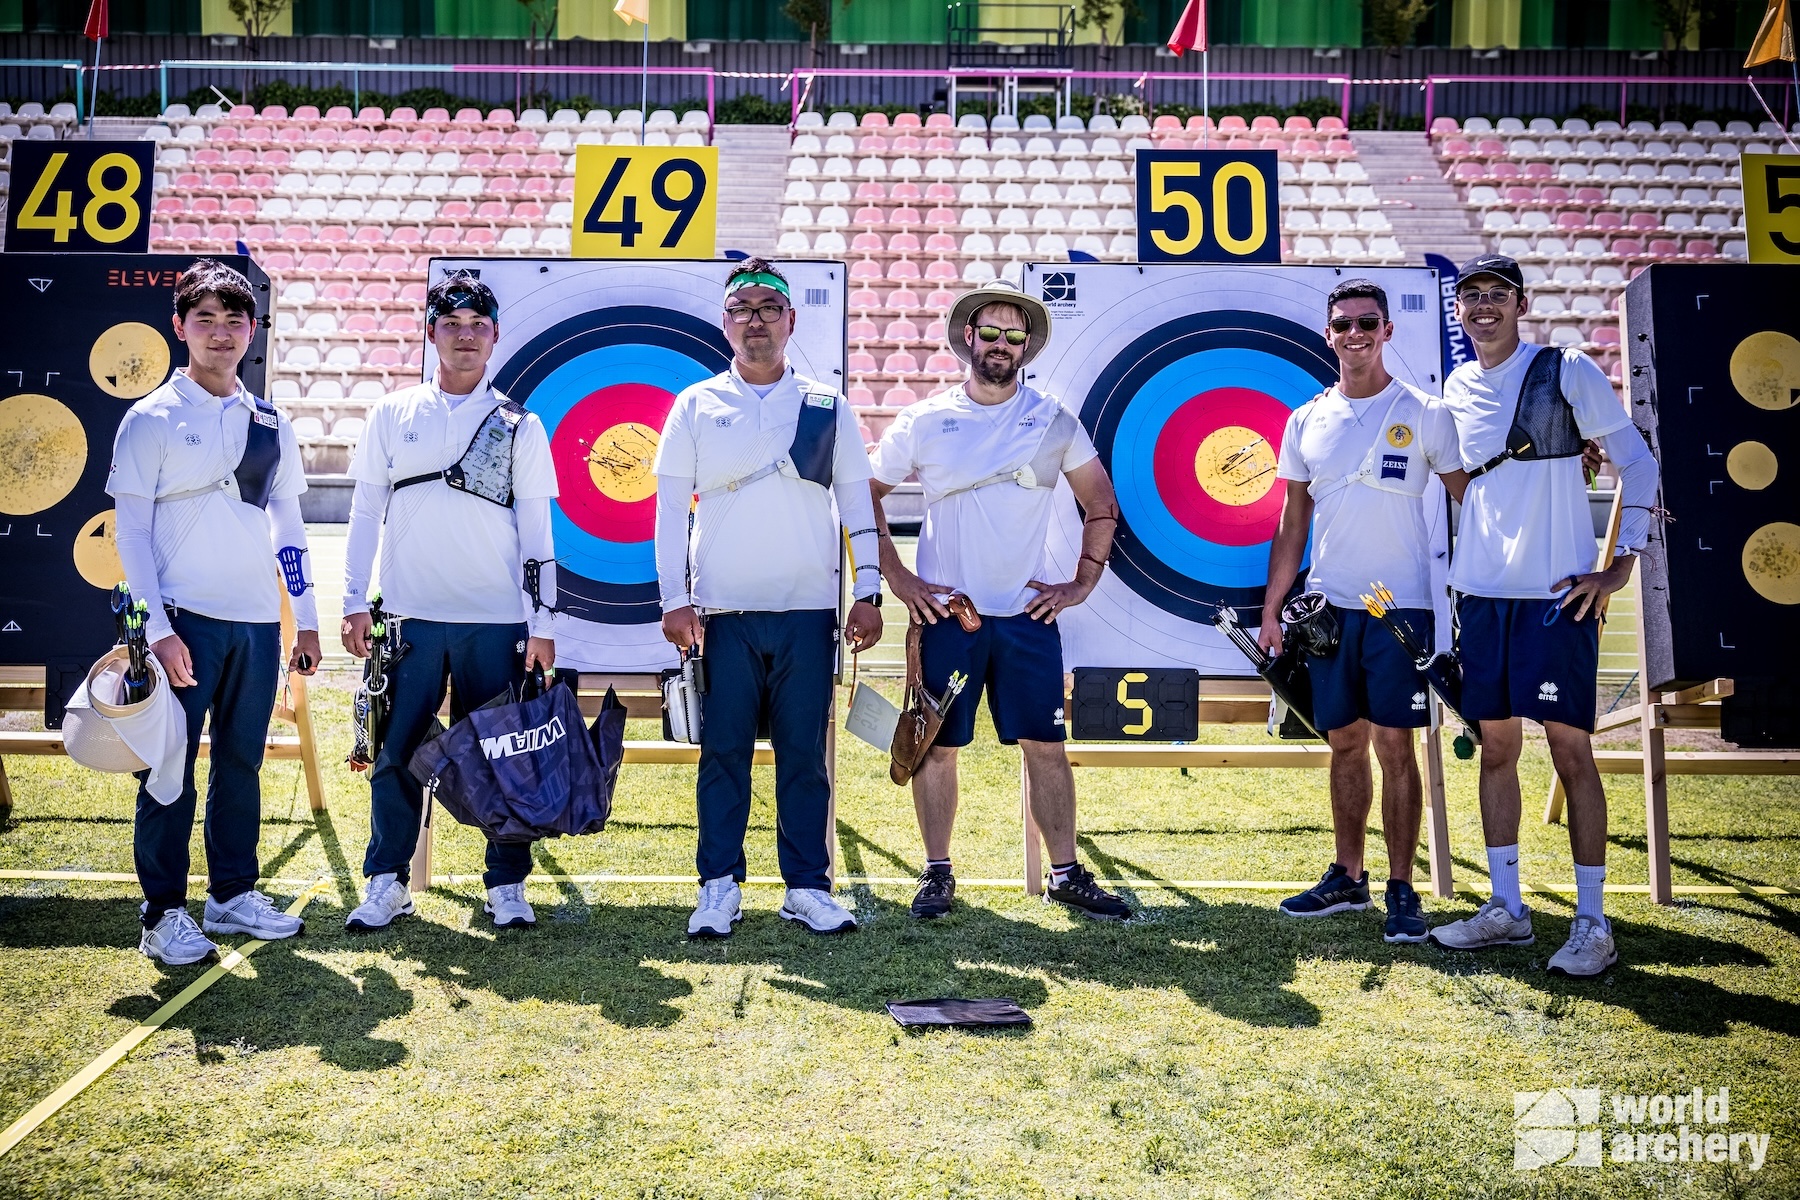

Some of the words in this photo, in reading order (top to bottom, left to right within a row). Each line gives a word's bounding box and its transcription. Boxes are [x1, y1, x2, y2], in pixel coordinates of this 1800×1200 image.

[17, 152, 142, 243] 48
[583, 157, 707, 248] 49
[1150, 161, 1267, 255] 50
[1440, 275, 1467, 368] HYUNDAI
[1383, 460, 1407, 470] ZEISS
[479, 716, 566, 760] WIAW
[1116, 672, 1153, 736] 5
